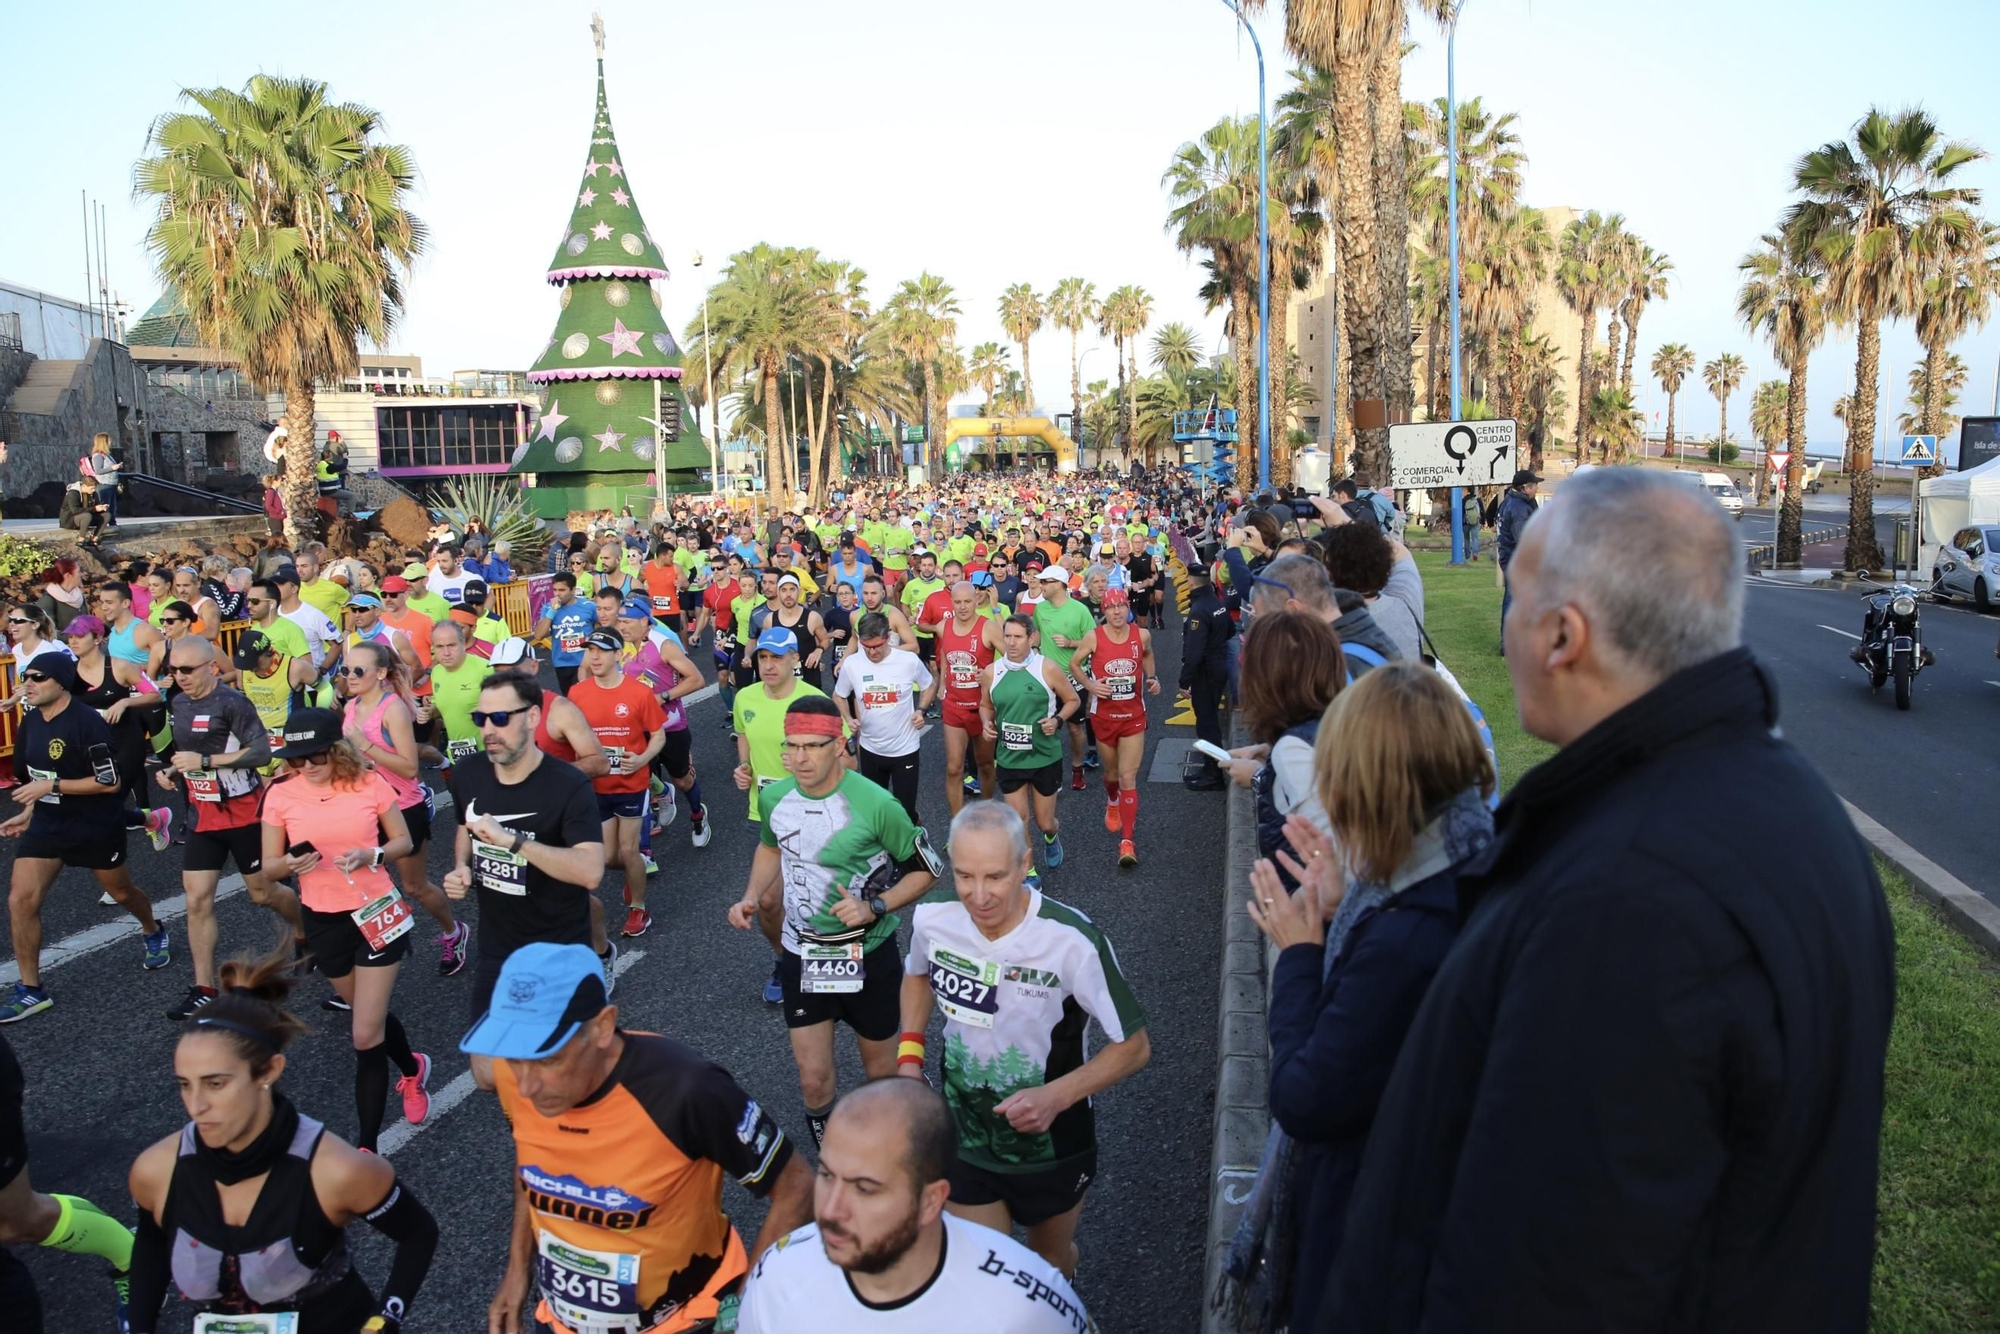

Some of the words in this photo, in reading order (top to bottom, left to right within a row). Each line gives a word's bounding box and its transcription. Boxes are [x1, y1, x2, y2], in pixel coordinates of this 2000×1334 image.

[1476, 425, 1513, 435] CENTRO
[1477, 434, 1511, 444] CIUDAD
[1402, 466, 1455, 476] COMERCIAL
[1410, 475, 1444, 485] CIUDAD
[565, 638, 581, 647] 603
[955, 673, 972, 681] 863
[870, 692, 889, 702] 721
[1004, 732, 1029, 743] 5022
[454, 746, 477, 757] 4073
[190, 780, 212, 791] 1122
[480, 859, 519, 880] 4281
[370, 903, 404, 931] 764
[807, 960, 859, 976] 4460
[986, 972, 994, 983] 3
[932, 968, 990, 1005] 4027
[1017, 987, 1050, 1000] TUKUMS
[619, 1268, 630, 1281] 2
[550, 1263, 621, 1308] 3615
